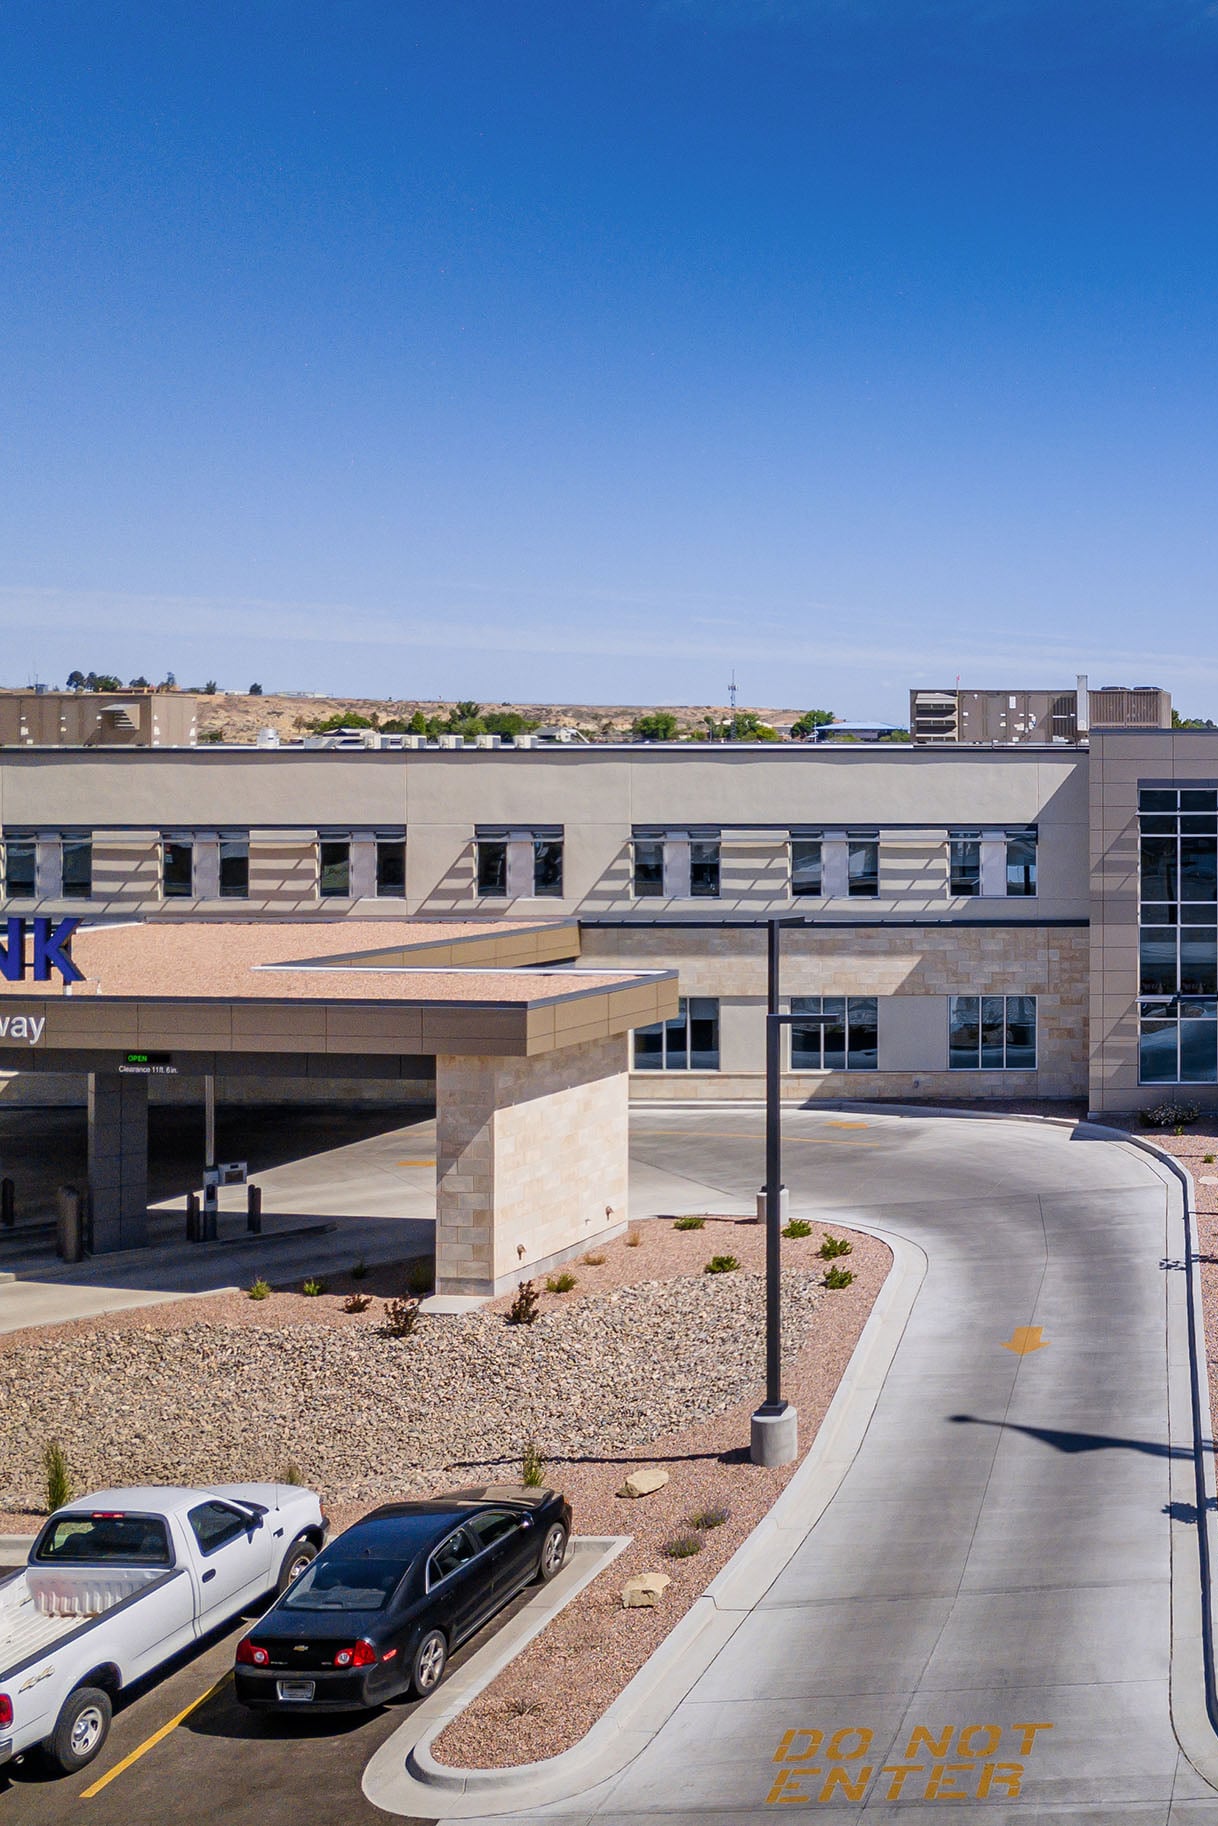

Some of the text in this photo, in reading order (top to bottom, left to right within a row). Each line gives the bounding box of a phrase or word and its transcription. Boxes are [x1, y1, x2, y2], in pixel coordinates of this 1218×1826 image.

[118, 1065, 151, 1073] Clearance
[771, 1723, 1054, 1763] DO NOT
[765, 1762, 1026, 1804] ENTER
